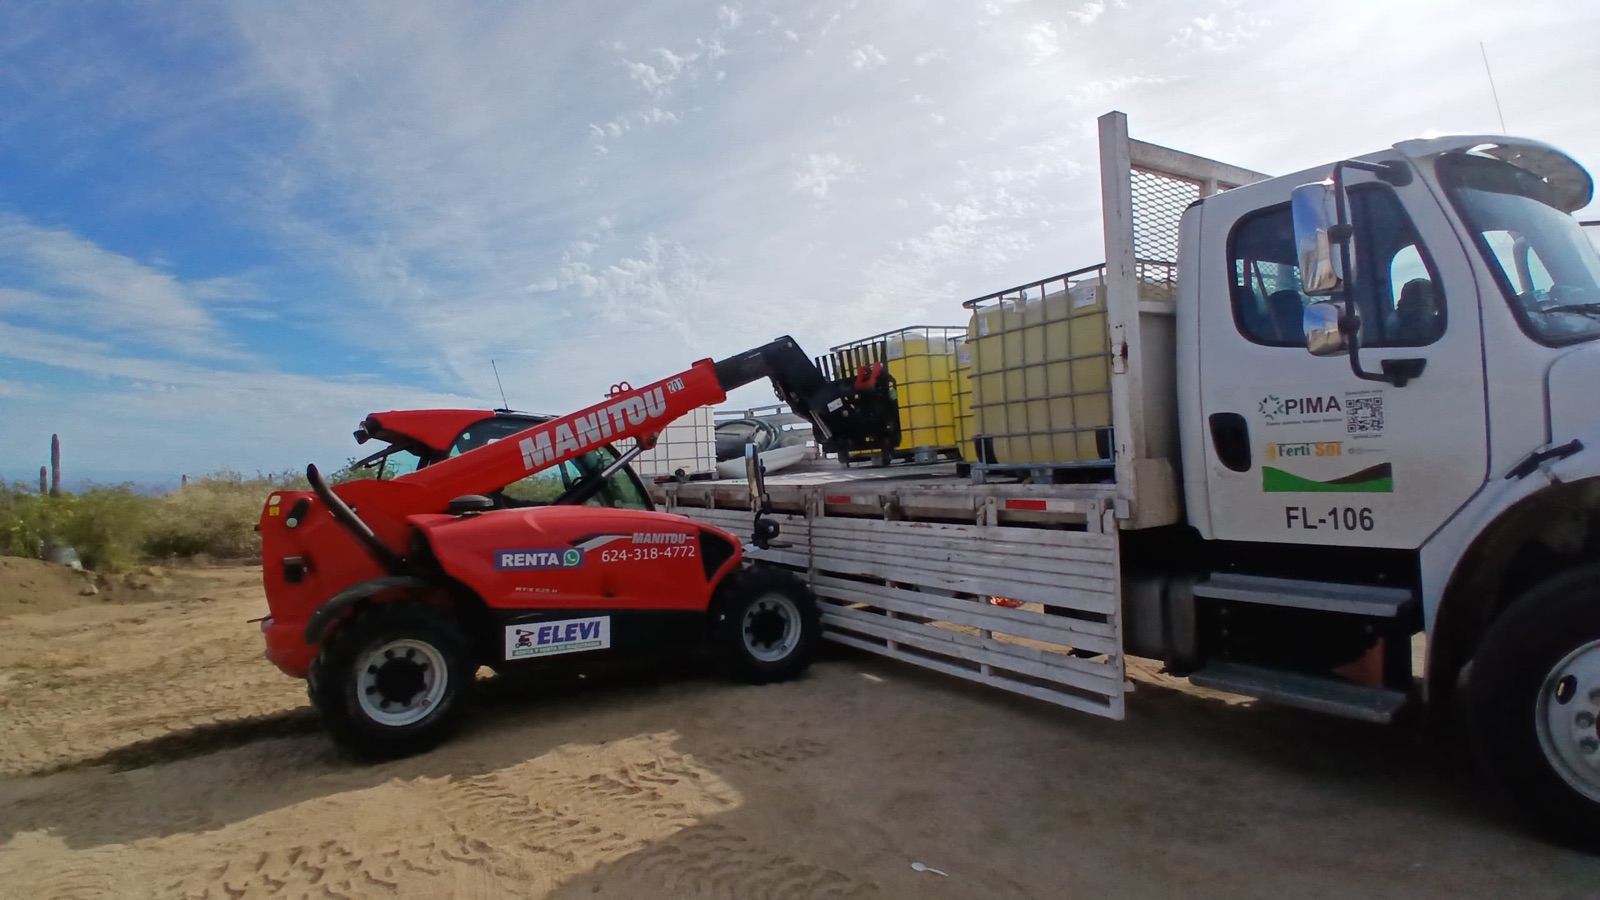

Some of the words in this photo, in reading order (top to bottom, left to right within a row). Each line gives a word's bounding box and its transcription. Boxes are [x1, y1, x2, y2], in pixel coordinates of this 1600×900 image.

[667, 378, 684, 393] 201
[1284, 395, 1342, 415] PIMA
[518, 386, 667, 471] MANITOU
[1278, 443, 1311, 457] Ferti
[1315, 441, 1342, 457] Sol
[1285, 506, 1375, 531] FL-106
[631, 531, 687, 544] MANITOU
[501, 552, 560, 567] RENTA
[601, 545, 696, 563] 624-318-4772
[536, 620, 601, 646] ELEVI
